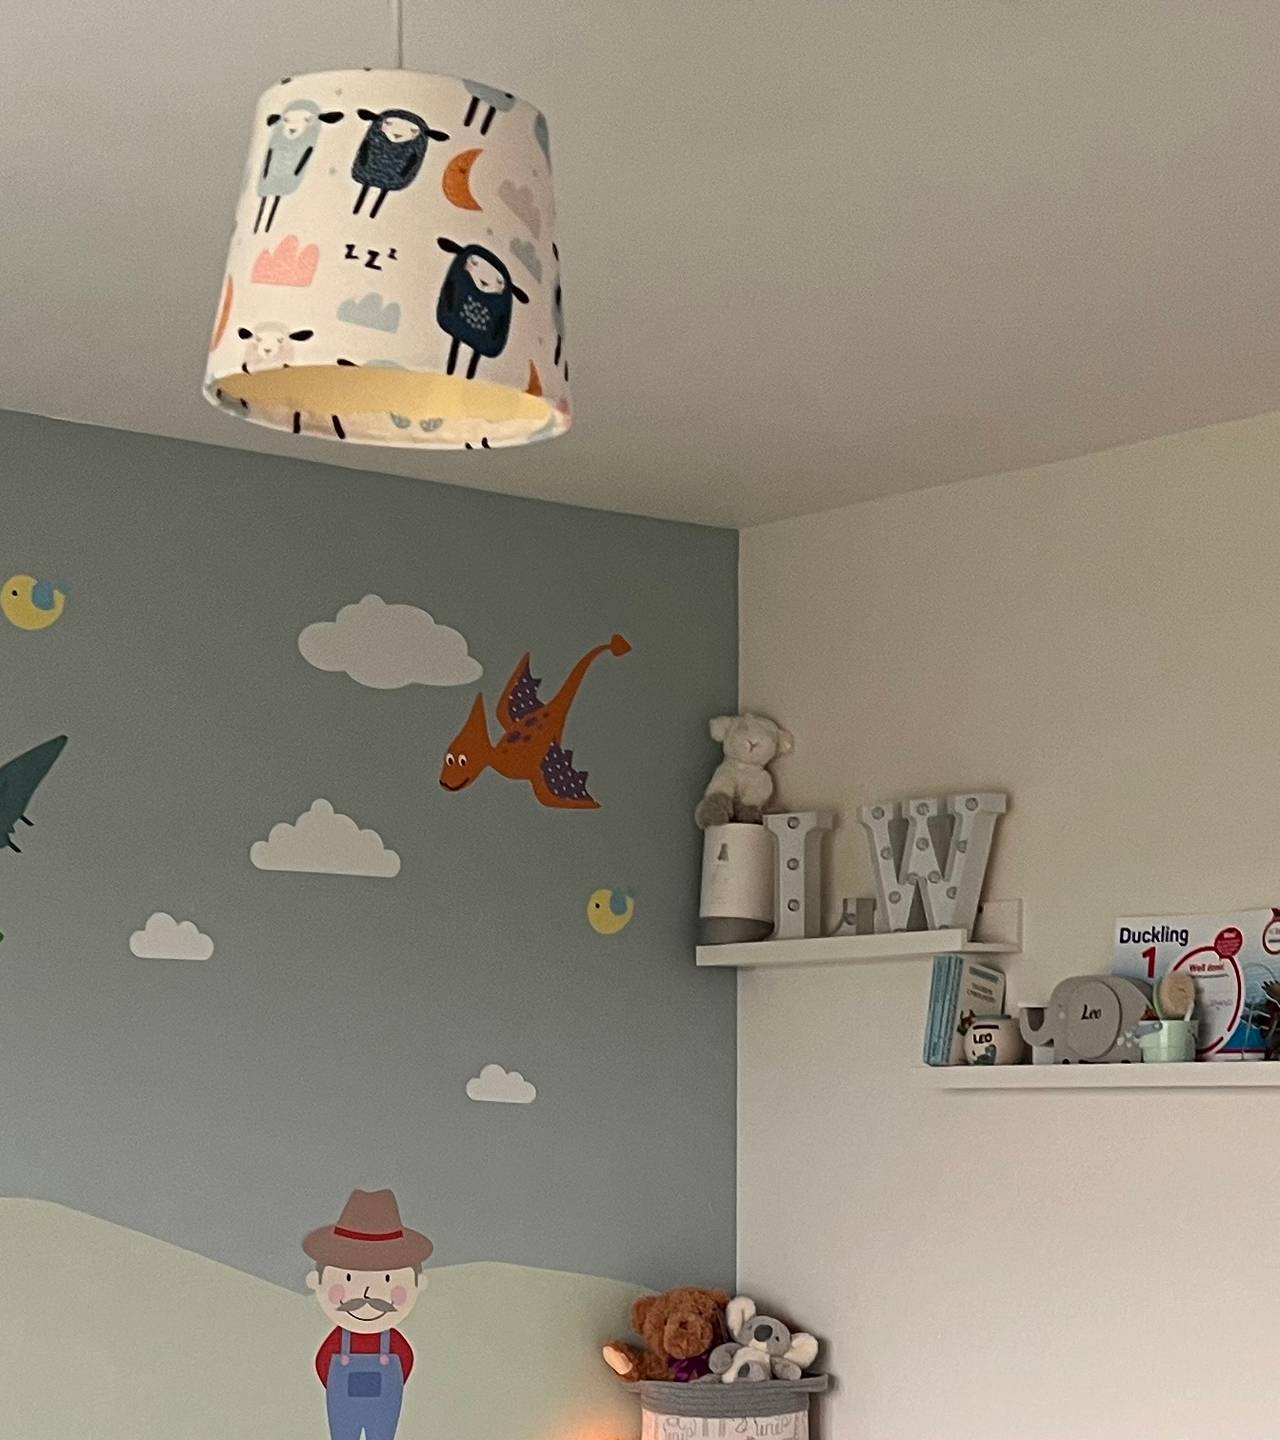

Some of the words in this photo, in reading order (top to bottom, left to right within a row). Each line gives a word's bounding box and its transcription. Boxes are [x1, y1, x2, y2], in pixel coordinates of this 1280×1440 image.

[857, 793, 1007, 941] W
[1120, 925, 1189, 947] Duckling
[1142, 946, 1157, 979] 1
[1080, 1004, 1103, 1021] Leo
[973, 1032, 993, 1045] LEO
